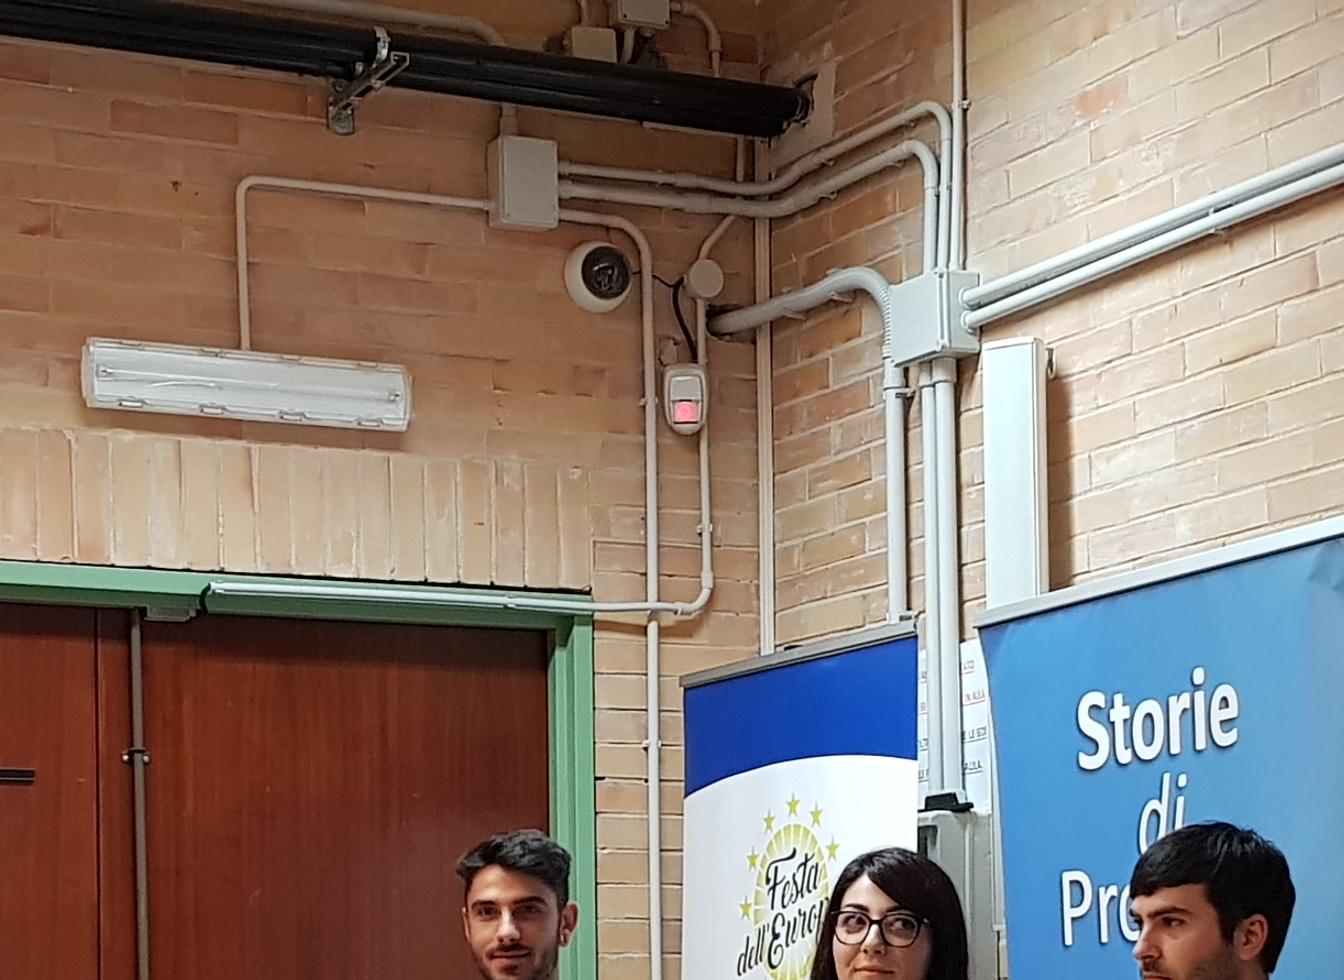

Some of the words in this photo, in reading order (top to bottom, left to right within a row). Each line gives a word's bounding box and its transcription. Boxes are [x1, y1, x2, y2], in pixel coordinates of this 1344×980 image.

[1076, 666, 1239, 771] Storie
[1138, 772, 1188, 856] di
[765, 847, 819, 911] Festa
